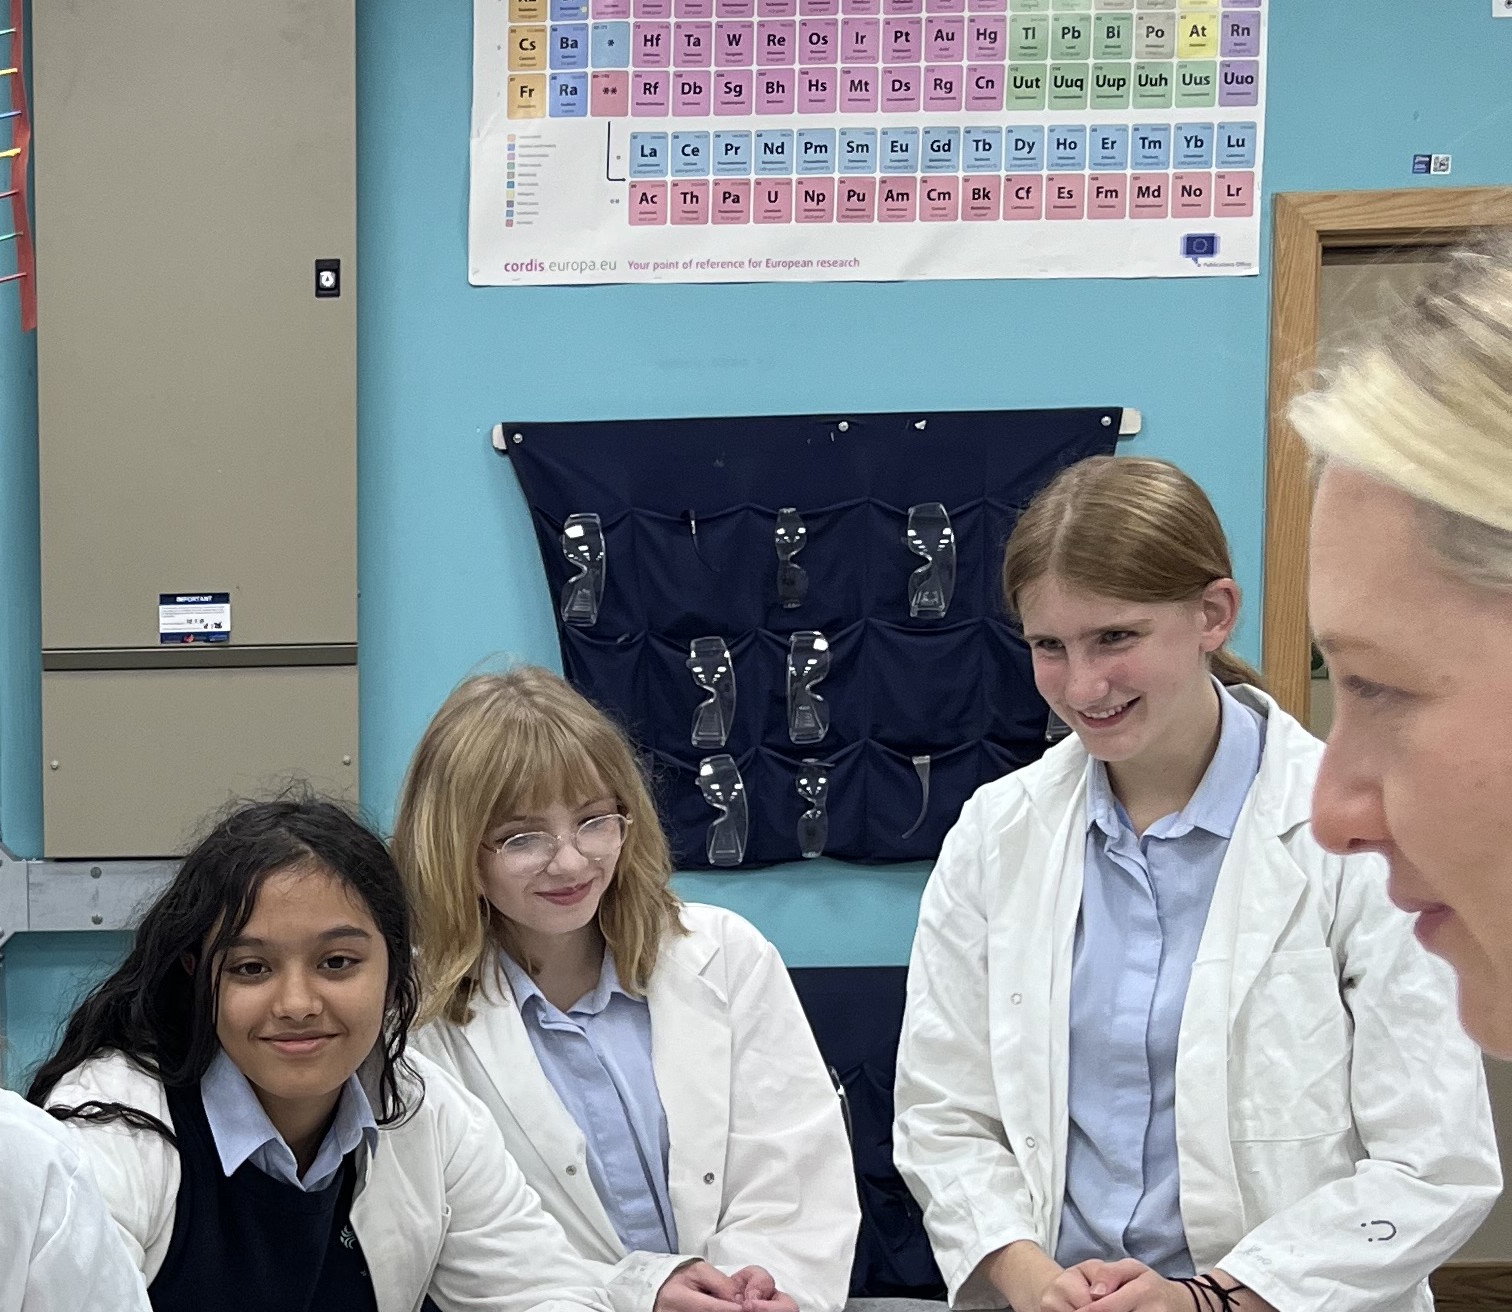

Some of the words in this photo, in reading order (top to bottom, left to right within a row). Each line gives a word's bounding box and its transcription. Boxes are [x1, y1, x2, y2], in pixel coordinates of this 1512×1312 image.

[519, 38, 536, 51] Cs
[560, 37, 578, 49] Ba
[644, 34, 661, 47] Hf
[684, 34, 700, 47] Ta
[727, 34, 741, 46] W
[767, 34, 786, 46] Re
[809, 33, 828, 45] Os
[855, 32, 866, 44] Ir
[894, 31, 910, 43] Pt
[934, 29, 954, 41] Au
[977, 28, 997, 44] Hg
[1022, 27, 1035, 39] Tl
[1062, 26, 1081, 39] Pb
[1107, 26, 1120, 39] Bi
[1146, 26, 1164, 38] Po
[1189, 25, 1206, 37] At
[1231, 24, 1250, 36] Rn
[520, 86, 534, 98] Fr
[560, 84, 577, 96] Ra
[643, 82, 659, 95] Rf
[682, 82, 702, 95] Db
[724, 82, 742, 97] Sg
[766, 81, 785, 94] Bh
[809, 79, 827, 92] Hs
[850, 80, 869, 92] Mt
[892, 79, 910, 92] Ds
[934, 78, 953, 94] Rg
[976, 76, 994, 89] Cn
[1014, 76, 1040, 88] Uut
[1054, 76, 1083, 91] Uuq
[1096, 75, 1126, 91] Uup
[1139, 73, 1168, 87] Uuh
[1183, 73, 1210, 85] Uus
[1224, 72, 1253, 85] Uuo
[641, 145, 657, 157] La
[682, 144, 699, 156] Ce
[725, 143, 740, 155] Pr
[764, 142, 784, 154] Nd
[804, 142, 827, 154] Pm
[847, 141, 869, 153] Sm
[891, 141, 908, 153] Eu
[931, 139, 951, 152] Gd
[973, 139, 992, 152] Tb
[1015, 139, 1035, 154] Dy
[1057, 138, 1077, 150] Ho
[1102, 138, 1116, 150] Er
[1139, 137, 1161, 149] Tm
[1184, 135, 1203, 148] Yb
[1228, 135, 1245, 147] Lu
[639, 192, 657, 204] Ac
[680, 191, 698, 204] Th
[723, 191, 740, 204] Pa
[768, 191, 778, 203] U
[805, 190, 825, 205] Np
[847, 189, 865, 202] Pu
[885, 189, 909, 202] Am
[927, 189, 951, 201] Cm
[972, 187, 991, 200] Bk
[1015, 186, 1032, 199] Cf
[1058, 187, 1073, 199] Es
[1096, 186, 1118, 198] Fm
[1137, 185, 1161, 198] Md
[1181, 185, 1202, 197] No
[1227, 185, 1242, 196] Lr
[628, 260, 649, 269] Your
[653, 261, 678, 272] point
[682, 260, 693, 269] of
[696, 260, 745, 269] reference
[748, 259, 761, 267] for
[766, 258, 812, 270] European
[816, 258, 859, 267] research
